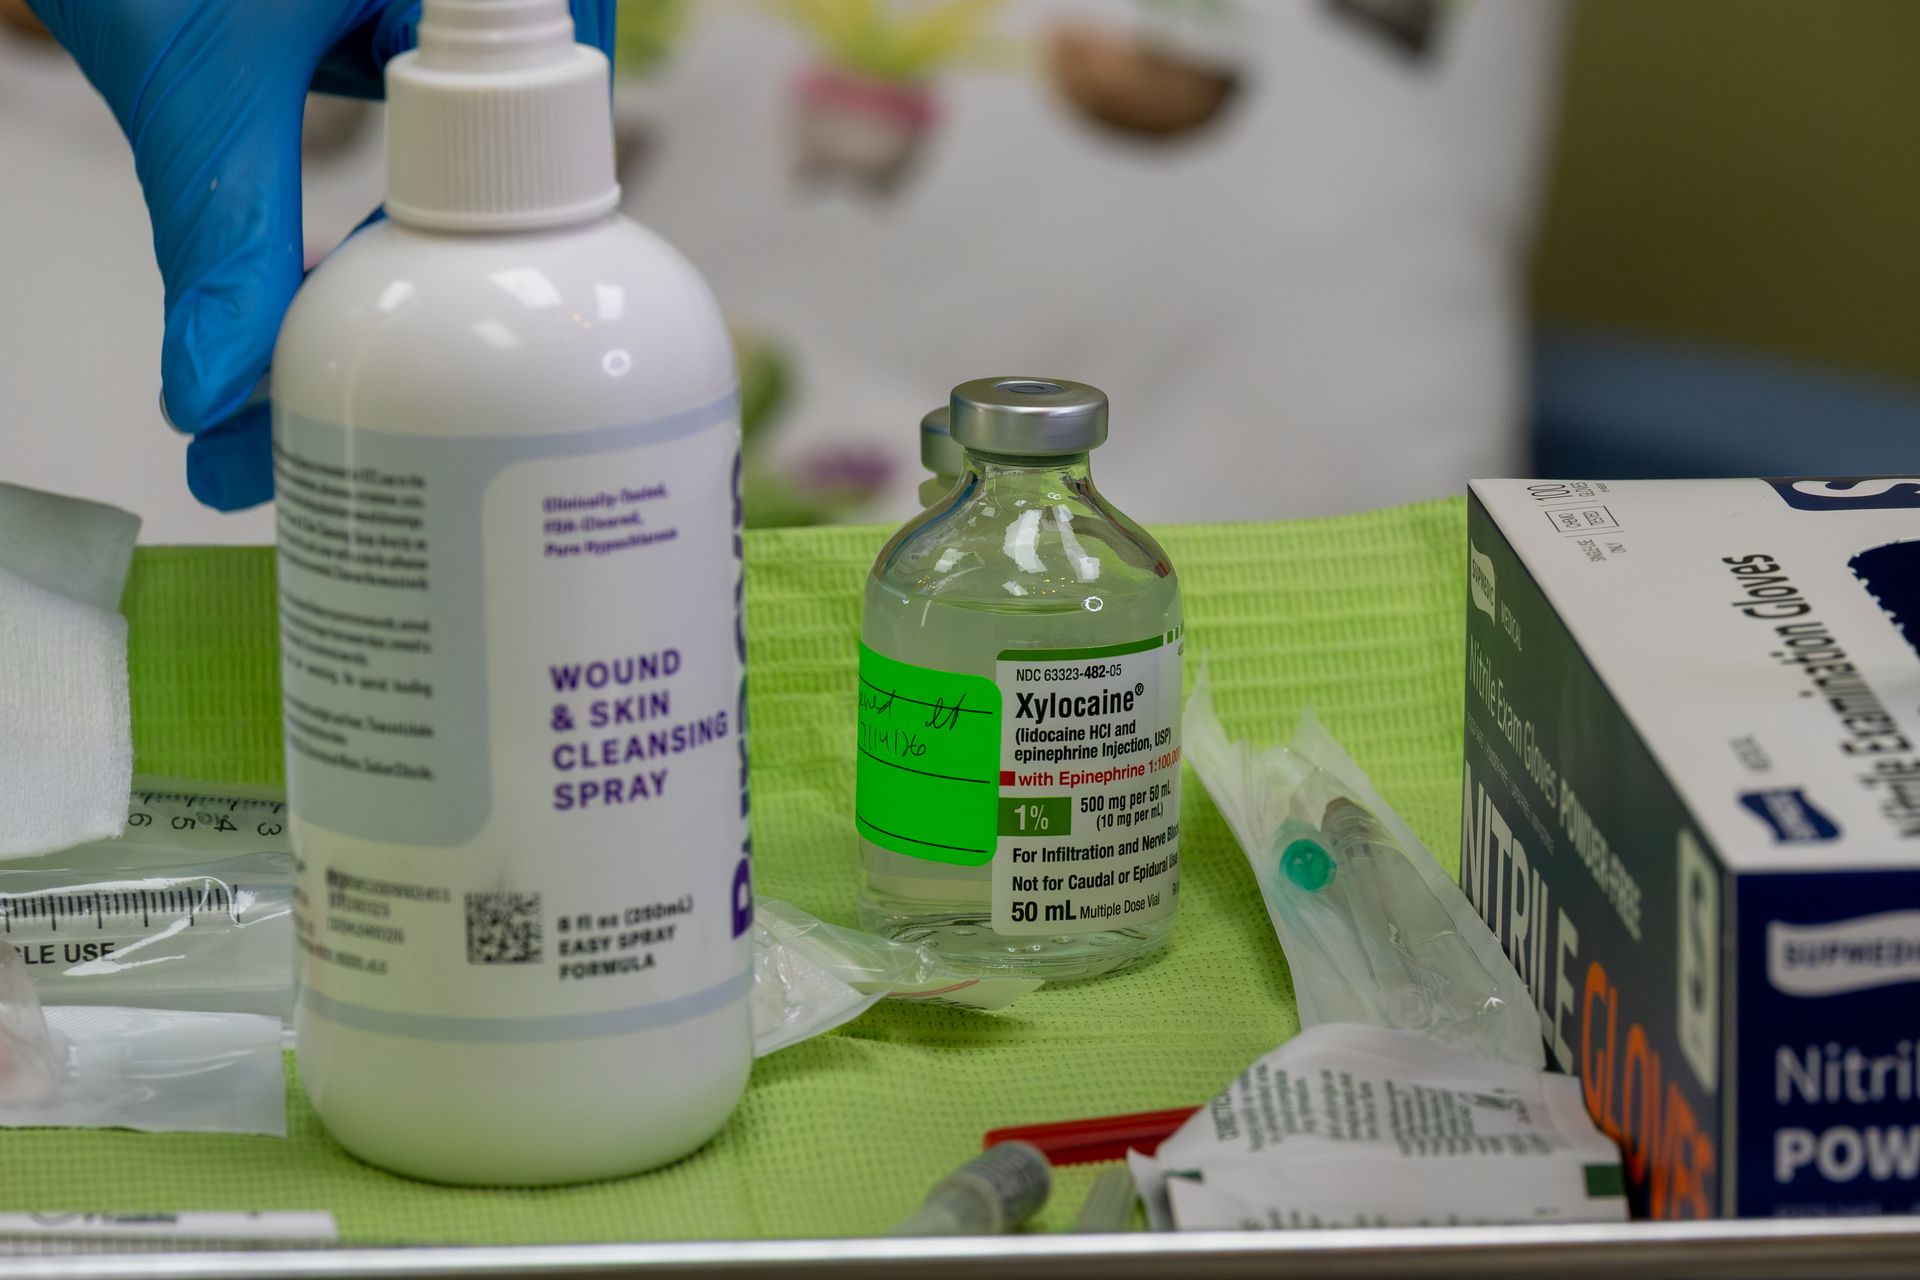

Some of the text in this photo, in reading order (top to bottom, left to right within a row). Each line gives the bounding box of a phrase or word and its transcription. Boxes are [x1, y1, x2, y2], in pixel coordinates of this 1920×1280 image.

[1527, 484, 1573, 501] 100
[1721, 554, 1812, 620] Gloves
[1500, 599, 1523, 653] MEDICAL
[549, 648, 681, 692] WOUND
[1016, 663, 1122, 682] NDC 63323-482-05
[1770, 621, 1913, 757] Examination
[551, 690, 669, 732] & SKIN
[552, 709, 729, 771] CLEANSING
[1014, 726, 1172, 764] epinephrine Injection, USP)
[1015, 727, 1086, 746] (lidocaine
[1114, 719, 1136, 737] and
[553, 768, 668, 811] SPRAY
[1018, 771, 1054, 787] with
[1058, 764, 1145, 788] Epinephrine
[1468, 633, 1497, 719] Nitrile
[1497, 678, 1523, 760] Exam
[1523, 718, 1557, 810] Gloves
[1558, 776, 1643, 942] POWDER-FREE
[1080, 779, 1172, 813] 500 mg per 50 mL
[1013, 804, 1050, 832] 1%
[1096, 801, 1164, 832] (10 mg per mL)
[1012, 847, 1038, 863] For
[1041, 844, 1115, 863] Infiltration
[1118, 838, 1140, 855] and
[1142, 832, 1166, 851] Nerve
[1012, 852, 1178, 892] Not for Caudal or Epidural Use
[1011, 892, 1160, 922] 50 mL Multiple Dose Vial
[1461, 760, 1578, 1077] NITRILE
[64, 942, 116, 964] USE
[557, 923, 676, 957] EASY SPRAY
[558, 952, 656, 981] FORMULA
